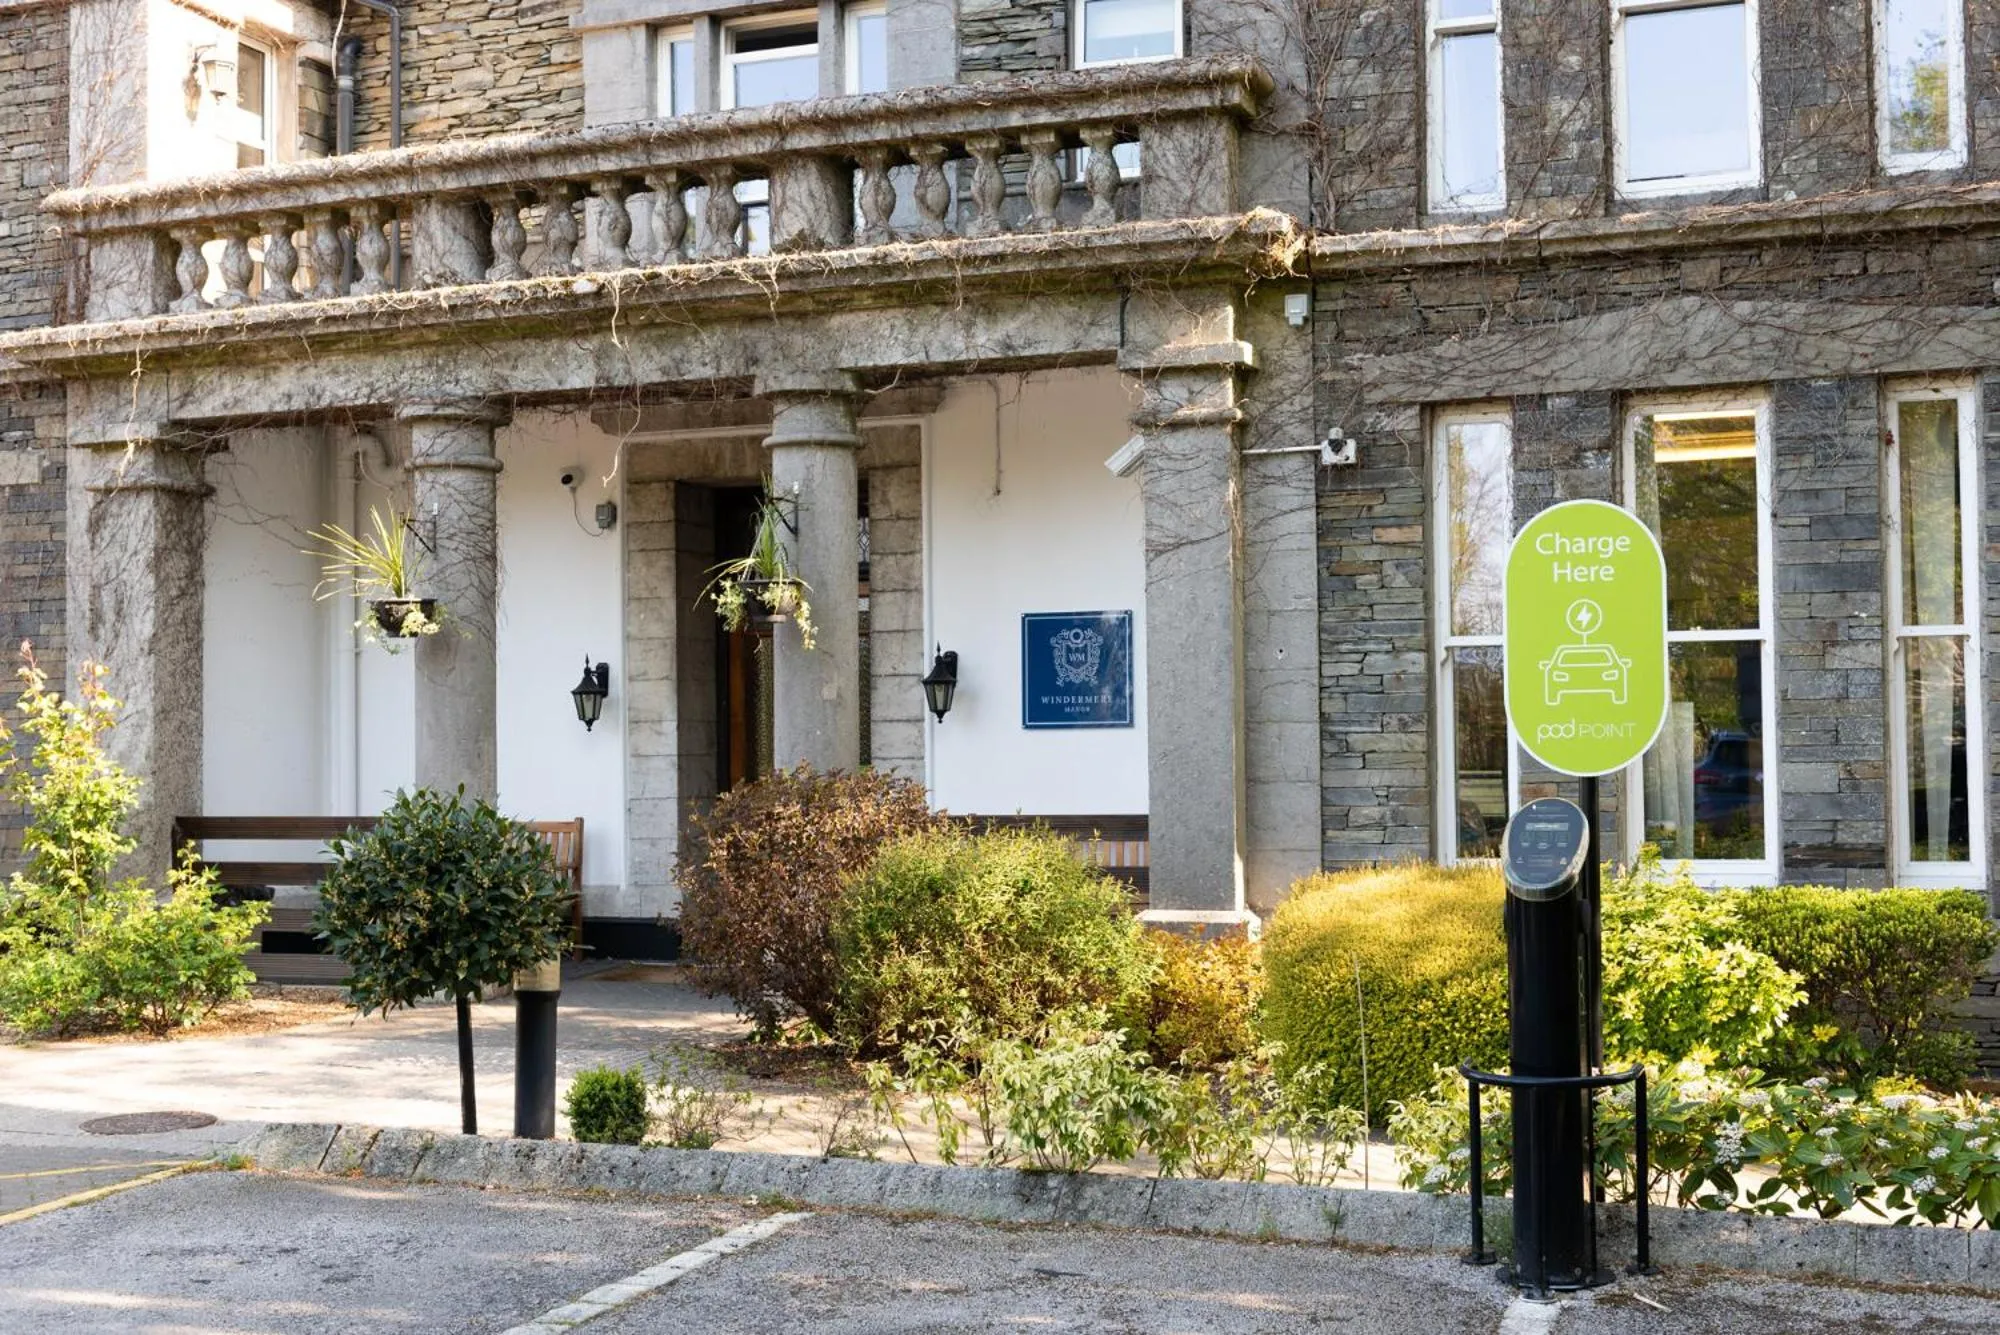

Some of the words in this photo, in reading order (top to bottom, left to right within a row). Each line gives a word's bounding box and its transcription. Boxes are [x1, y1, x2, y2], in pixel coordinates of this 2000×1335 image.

[1535, 533, 1631, 558] Charge
[1552, 564, 1614, 582] Here
[1068, 652, 1086, 662] WM
[1537, 718, 1575, 743] pod
[1577, 723, 1636, 738] POINT
